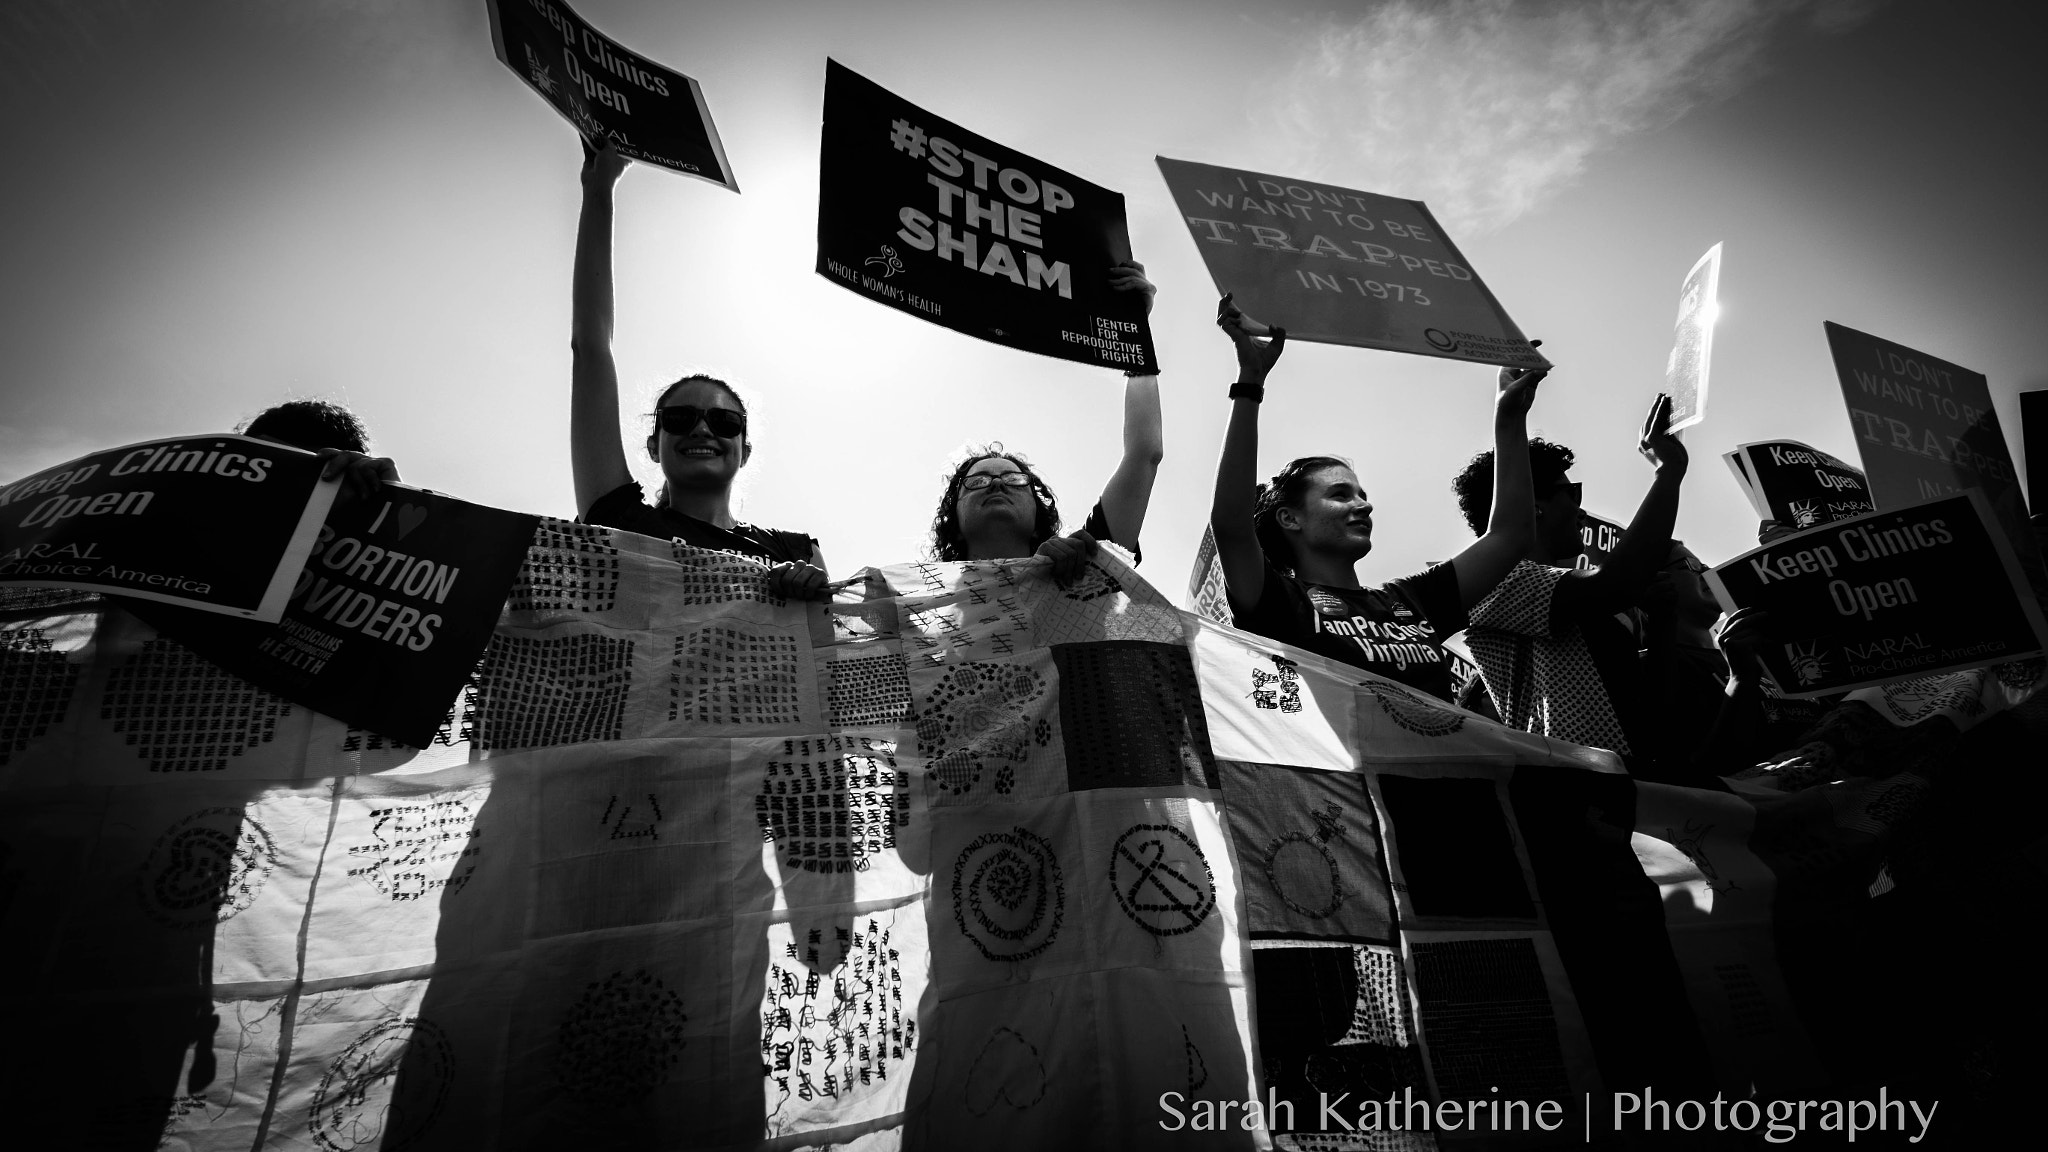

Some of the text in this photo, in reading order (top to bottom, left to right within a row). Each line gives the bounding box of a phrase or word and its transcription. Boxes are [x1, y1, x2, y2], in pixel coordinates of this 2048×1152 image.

[528, 0, 670, 97] eep Clinics
[563, 47, 631, 115] Open
[568, 93, 636, 147] NARAL
[643, 151, 700, 173] America
[890, 118, 1075, 214] #STOP
[927, 172, 1043, 249] THE
[1236, 177, 1369, 211] I DON'T
[1196, 189, 1432, 243] WANT TO BE
[897, 206, 1073, 300] SHAM
[1187, 216, 1473, 281] TRAPPED
[827, 258, 942, 316] WHOLE WOMAN'S HEALTH
[1296, 270, 1431, 306] IN 1973
[1061, 330, 1143, 354] REPRODUCTIVE
[1096, 317, 1139, 334] CENTER
[1097, 327, 1119, 341] FOR
[1101, 349, 1145, 366] RIGHTS
[1876, 348, 1954, 393] I DON'T
[1853, 368, 1991, 432] WANT TO BE
[109, 442, 273, 482] Clinics
[1768, 446, 1818, 468] Keep
[1814, 469, 1862, 492] Open
[1917, 477, 1942, 500] IN
[18, 491, 155, 528] Open
[367, 501, 393, 534] I
[0, 542, 103, 560] ARAL
[309, 523, 460, 604] BORTION
[1750, 517, 1954, 585] Keep Clinics
[96, 564, 212, 595] America
[291, 567, 443, 652] OVIDERS
[1828, 576, 1919, 622] Open
[278, 617, 343, 652] PHYSICIANS
[1322, 620, 1356, 636] am
[258, 637, 327, 675] HEALTH
[1352, 636, 1441, 671] Virginia
[1843, 632, 1932, 664] NARAL
[1850, 640, 2008, 679] Pro-Choice America
